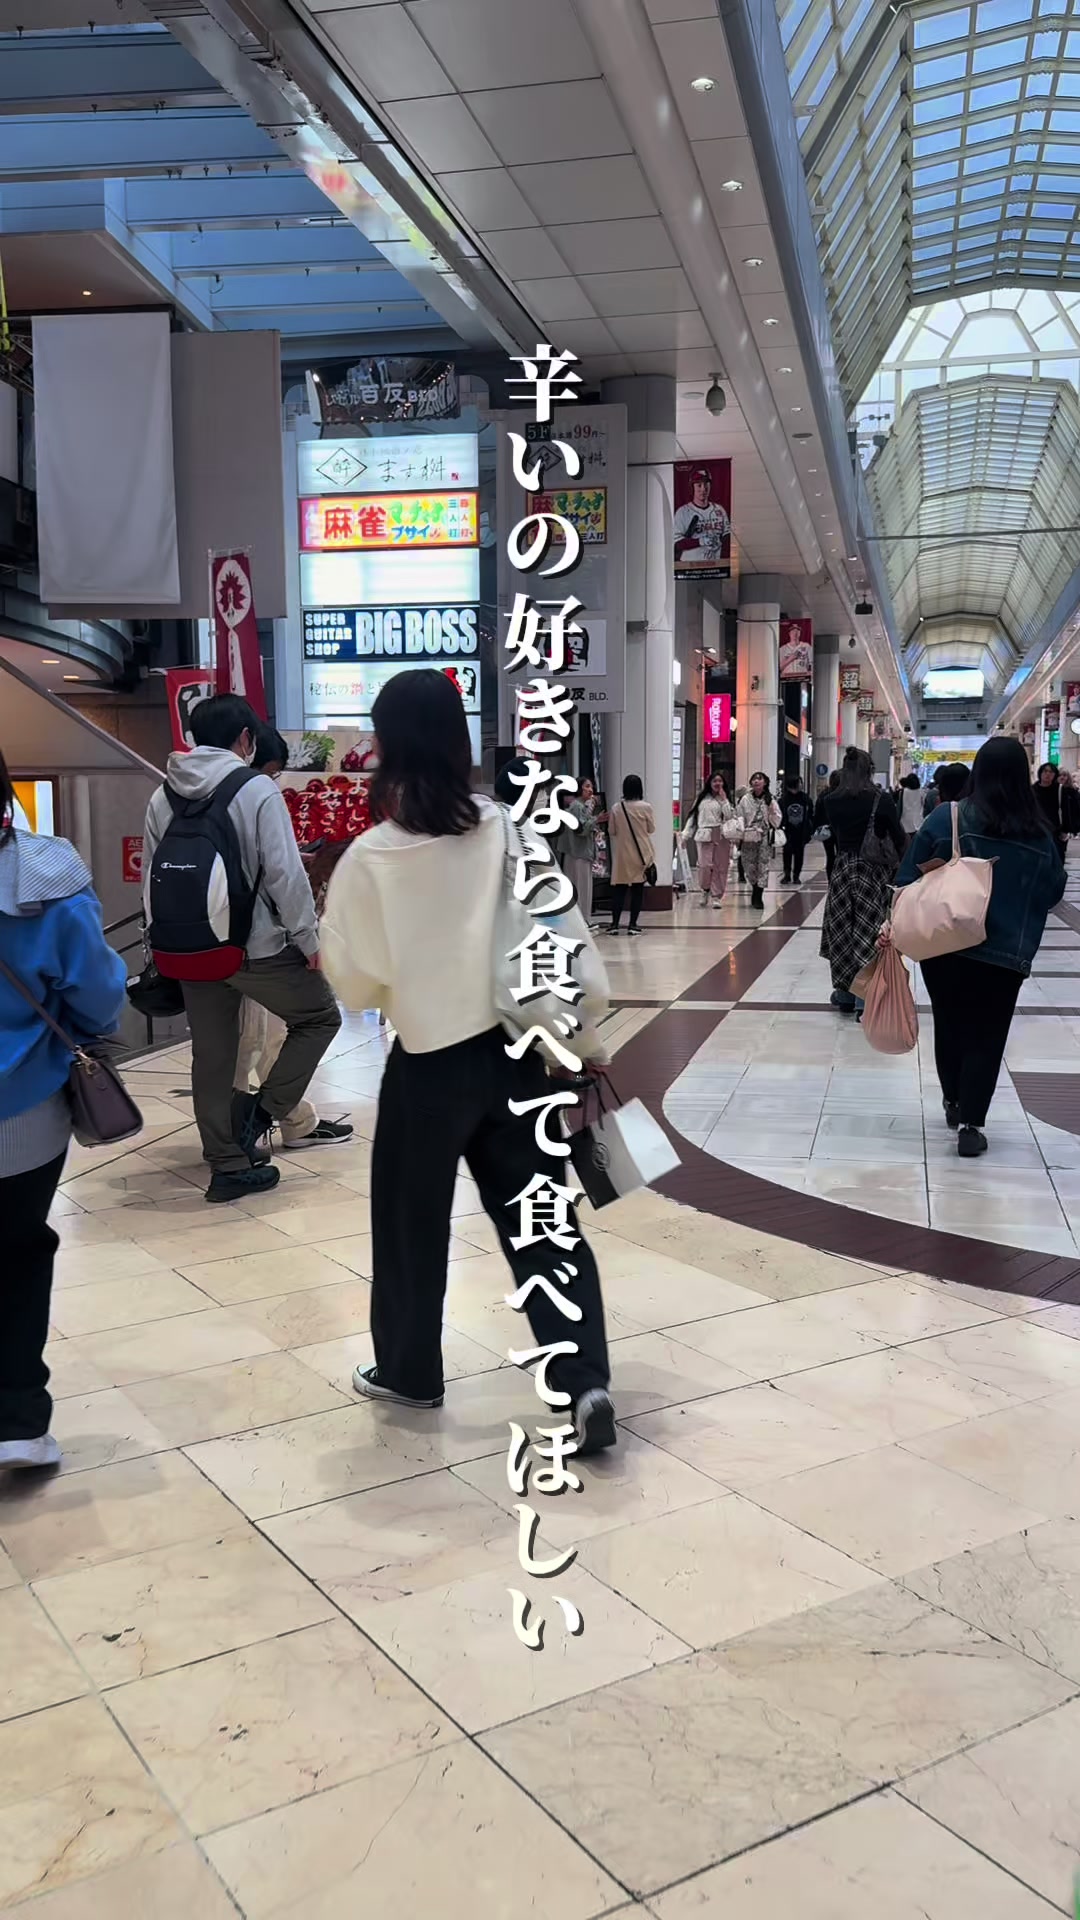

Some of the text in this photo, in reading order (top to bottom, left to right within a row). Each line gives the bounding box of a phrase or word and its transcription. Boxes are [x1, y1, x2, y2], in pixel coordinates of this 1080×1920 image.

[528, 424, 550, 440] 5F
[324, 505, 387, 540] 麻雀
[305, 612, 346, 626] SUPER
[305, 627, 352, 641] GUITAR
[355, 609, 478, 655] BIG BOSS
[306, 642, 341, 656] SHOP
[711, 697, 722, 739] Rakuten
